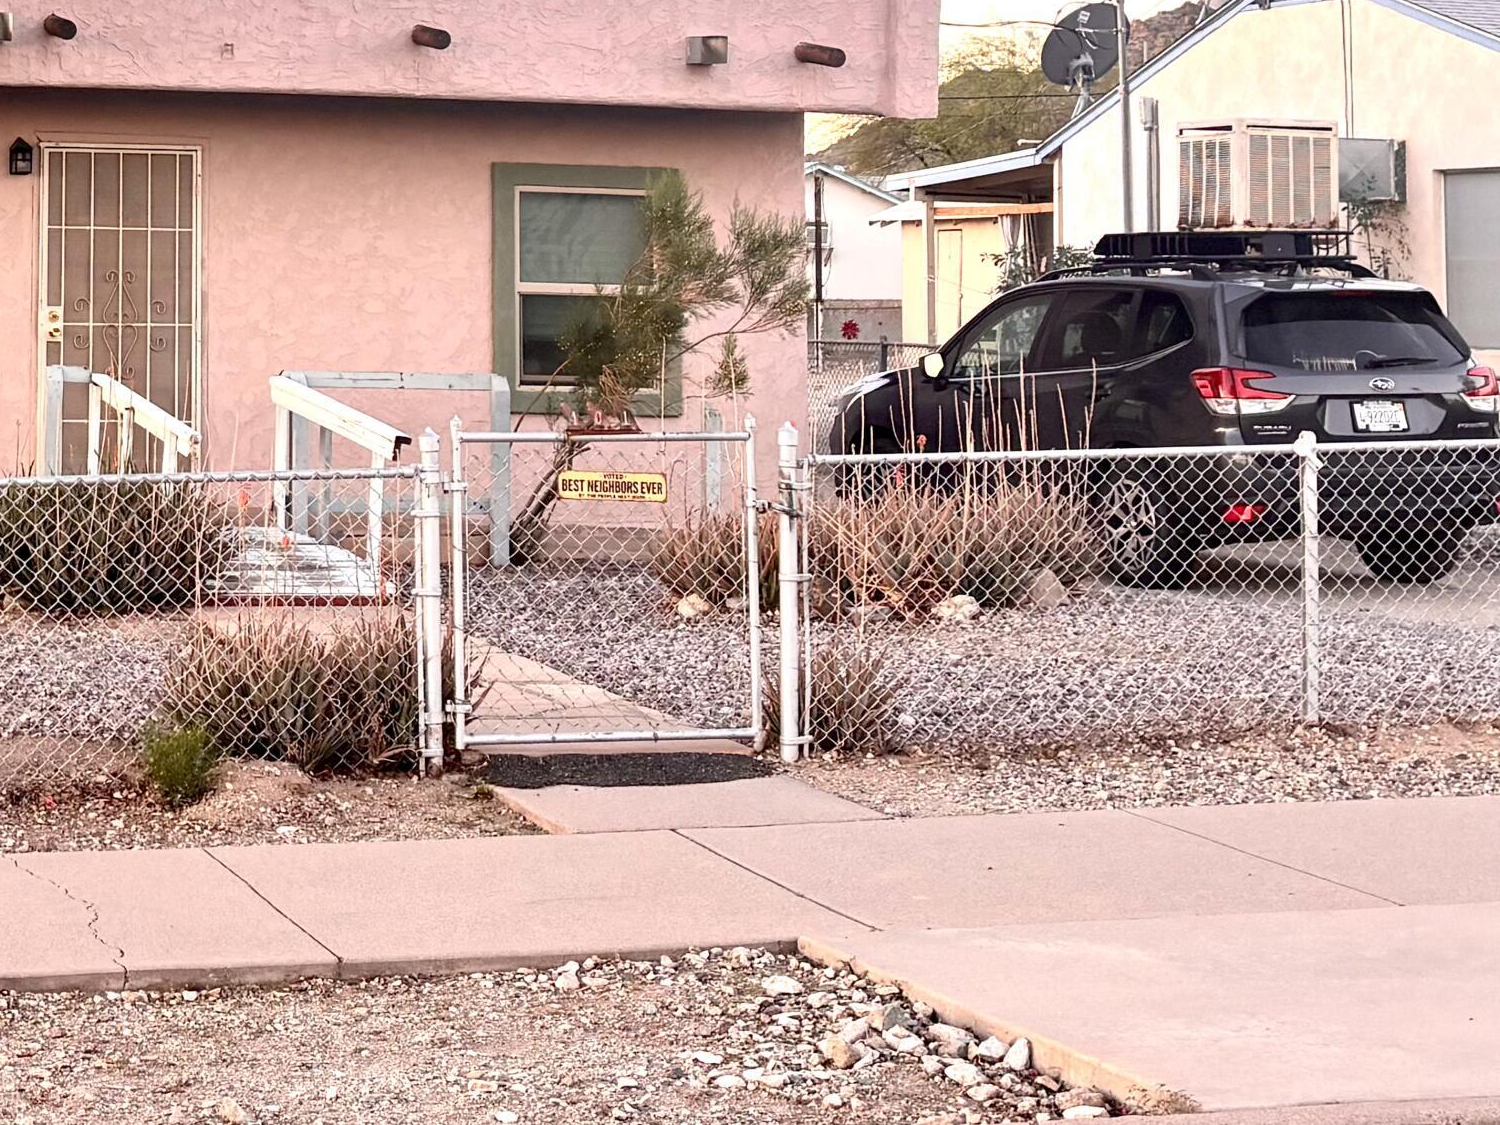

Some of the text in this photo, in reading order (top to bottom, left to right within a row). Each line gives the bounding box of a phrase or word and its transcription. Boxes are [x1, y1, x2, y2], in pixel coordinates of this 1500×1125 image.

[561, 479, 663, 495] BEST NEIGHBORS EVER
